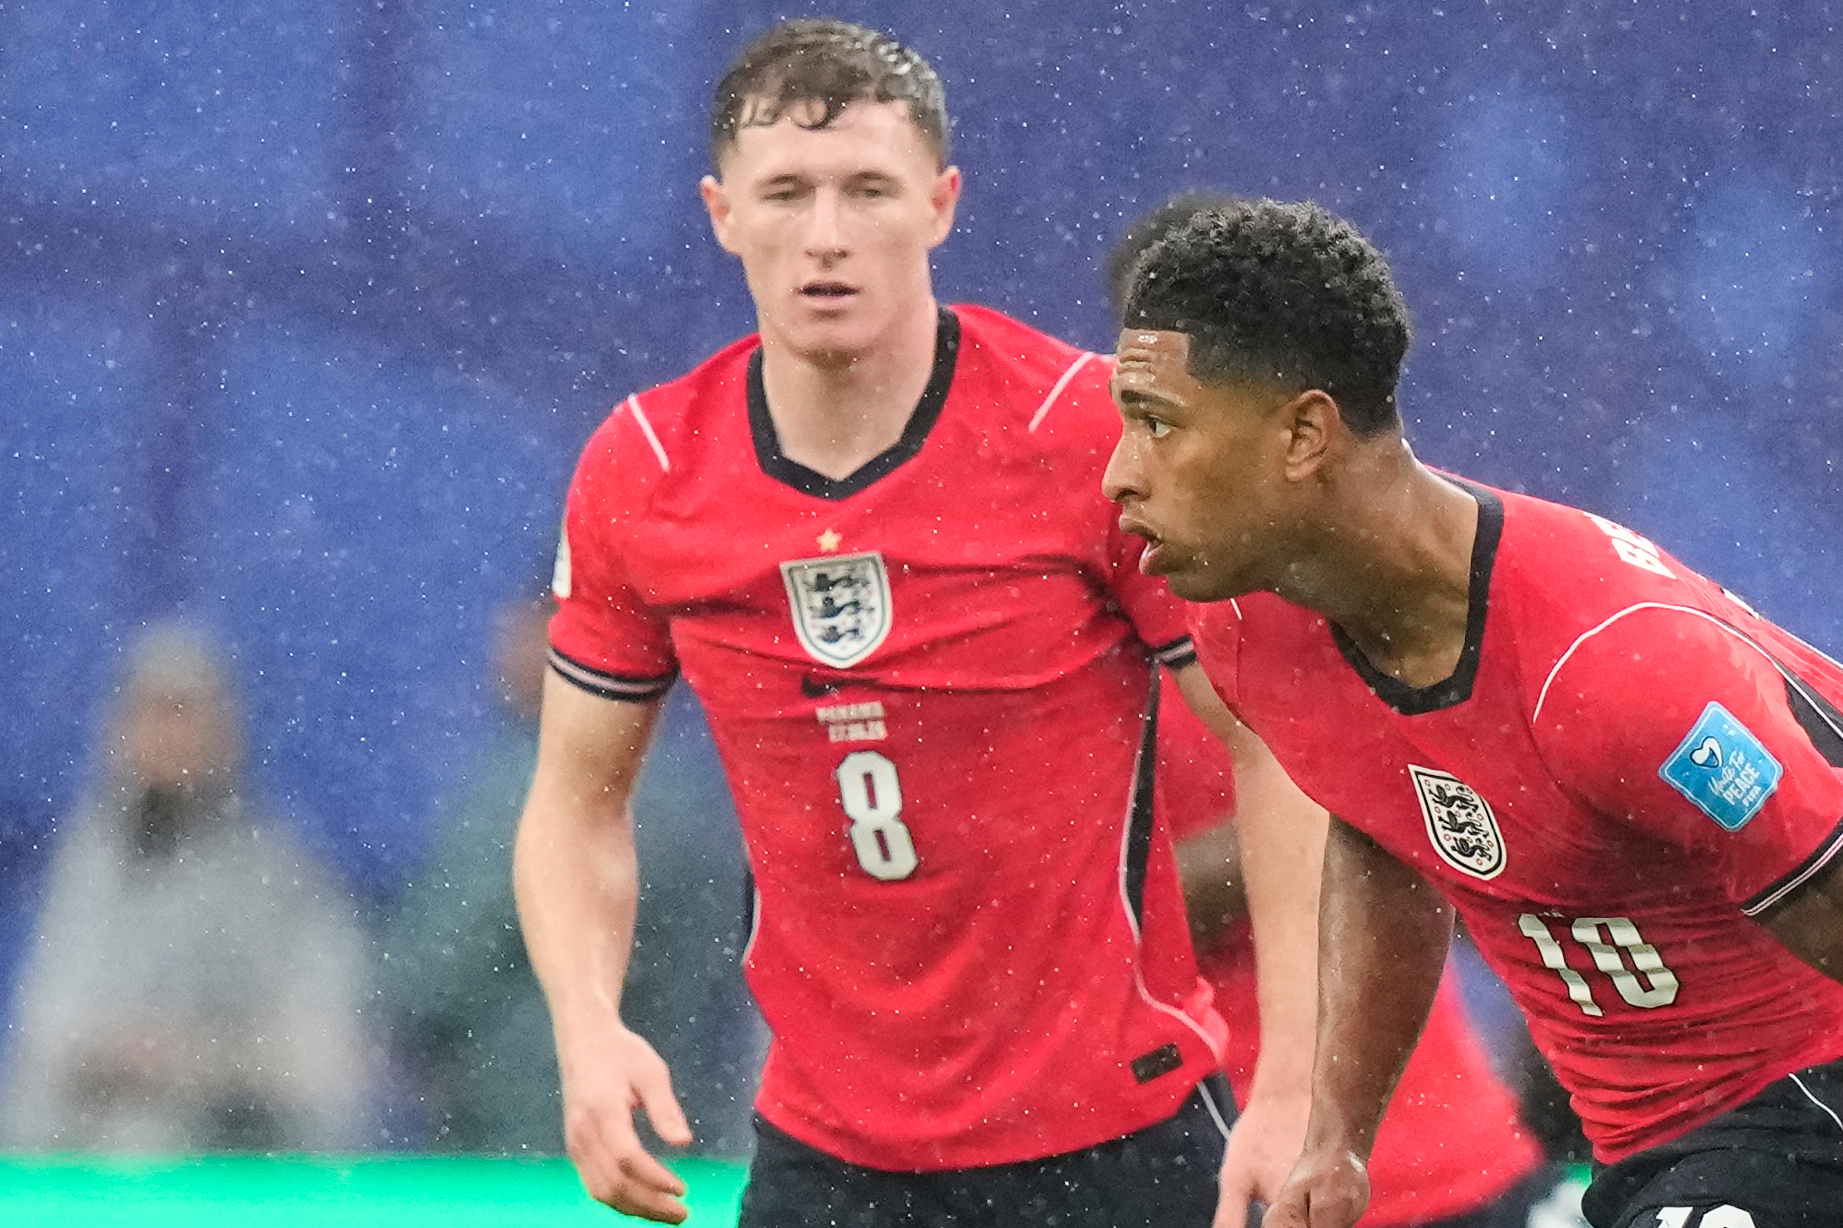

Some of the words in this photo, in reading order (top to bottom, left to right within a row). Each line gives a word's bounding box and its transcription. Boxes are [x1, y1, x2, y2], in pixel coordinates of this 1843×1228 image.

[835, 749, 918, 881] 8
[1722, 762, 1760, 806] PEACE
[1742, 785, 1761, 807] FIFA
[1518, 913, 1679, 1017] 10
